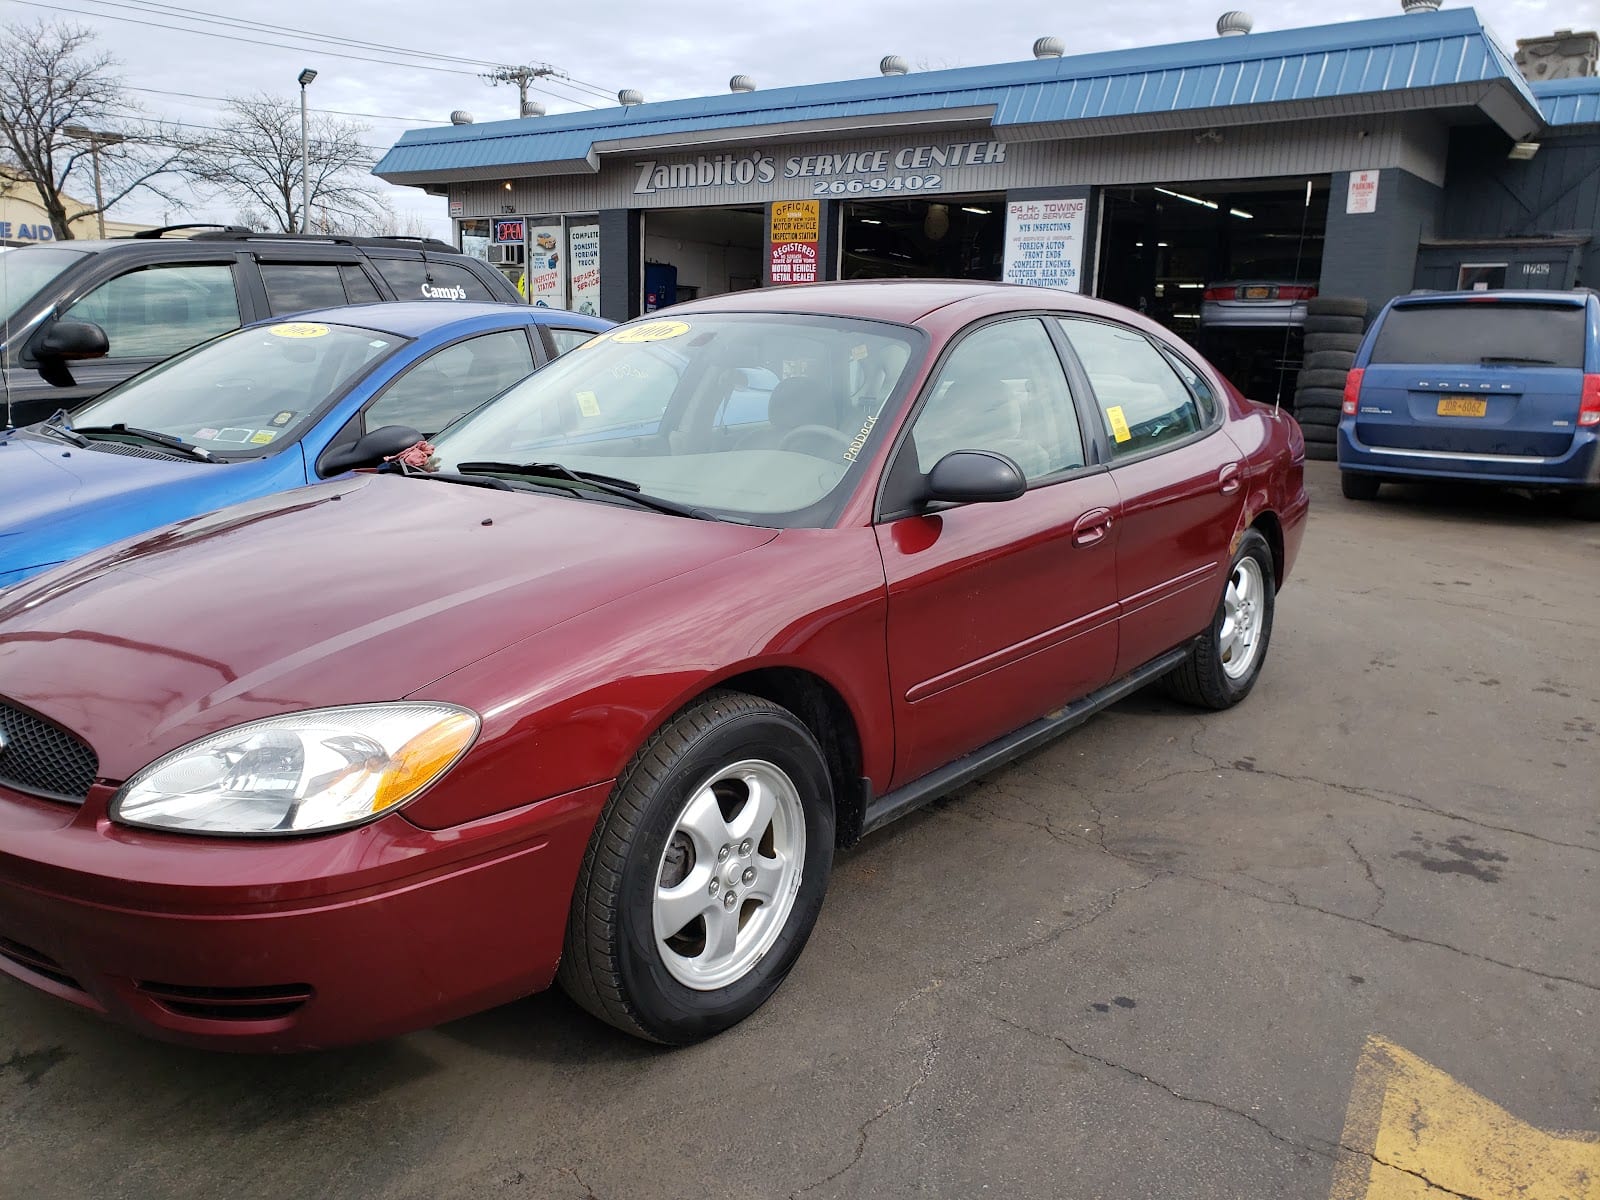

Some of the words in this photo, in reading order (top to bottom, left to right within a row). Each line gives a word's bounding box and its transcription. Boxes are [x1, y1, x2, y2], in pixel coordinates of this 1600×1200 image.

[633, 151, 775, 194] Zambito's
[783, 150, 890, 178] SERVICE
[894, 142, 1006, 170] CENTER
[813, 174, 942, 195] 266-9402
[1352, 182, 1374, 190] PARKING
[776, 203, 815, 216] OFFICIAL
[1010, 205, 1023, 214] 24
[1026, 204, 1040, 213] Hr.
[1043, 202, 1084, 212] TOWING
[1042, 212, 1076, 220] SERVICE
[773, 222, 792, 230] MOTOR
[793, 222, 816, 230] VEHICLE
[1019, 224, 1031, 232] NYS
[1032, 222, 1071, 231] INSPECTIONS
[18, 223, 53, 240] AID
[499, 223, 523, 240] OPEN
[572, 231, 599, 240] COMPLETE
[773, 232, 797, 240] INSPECTION
[798, 232, 816, 240] STATION
[574, 243, 598, 251] DOMESTIC
[773, 243, 815, 258] REGISTERED
[1019, 242, 1044, 250] FOREIGN
[1045, 241, 1065, 250] AUTOS
[1024, 251, 1043, 259] FRONT
[1045, 250, 1061, 258] ENDS
[578, 259, 595, 267] TRUCK
[772, 264, 791, 272] MOTOR
[793, 264, 816, 272] VEHICLE
[1014, 260, 1043, 268] COMPLETE
[1045, 260, 1071, 268] ENGINES
[534, 271, 558, 284] INSPECTION
[573, 269, 595, 284] REPAIRS
[772, 273, 792, 281] RETAIL
[793, 273, 815, 281] DEALER
[1008, 269, 1037, 278] CLUTCHES
[1041, 269, 1058, 277] REAR
[1059, 268, 1075, 277] ENDS
[538, 281, 556, 292] STATION
[577, 277, 600, 291] SERVICE
[1025, 278, 1068, 286] CONDITIONING
[421, 283, 466, 300] Camp's
